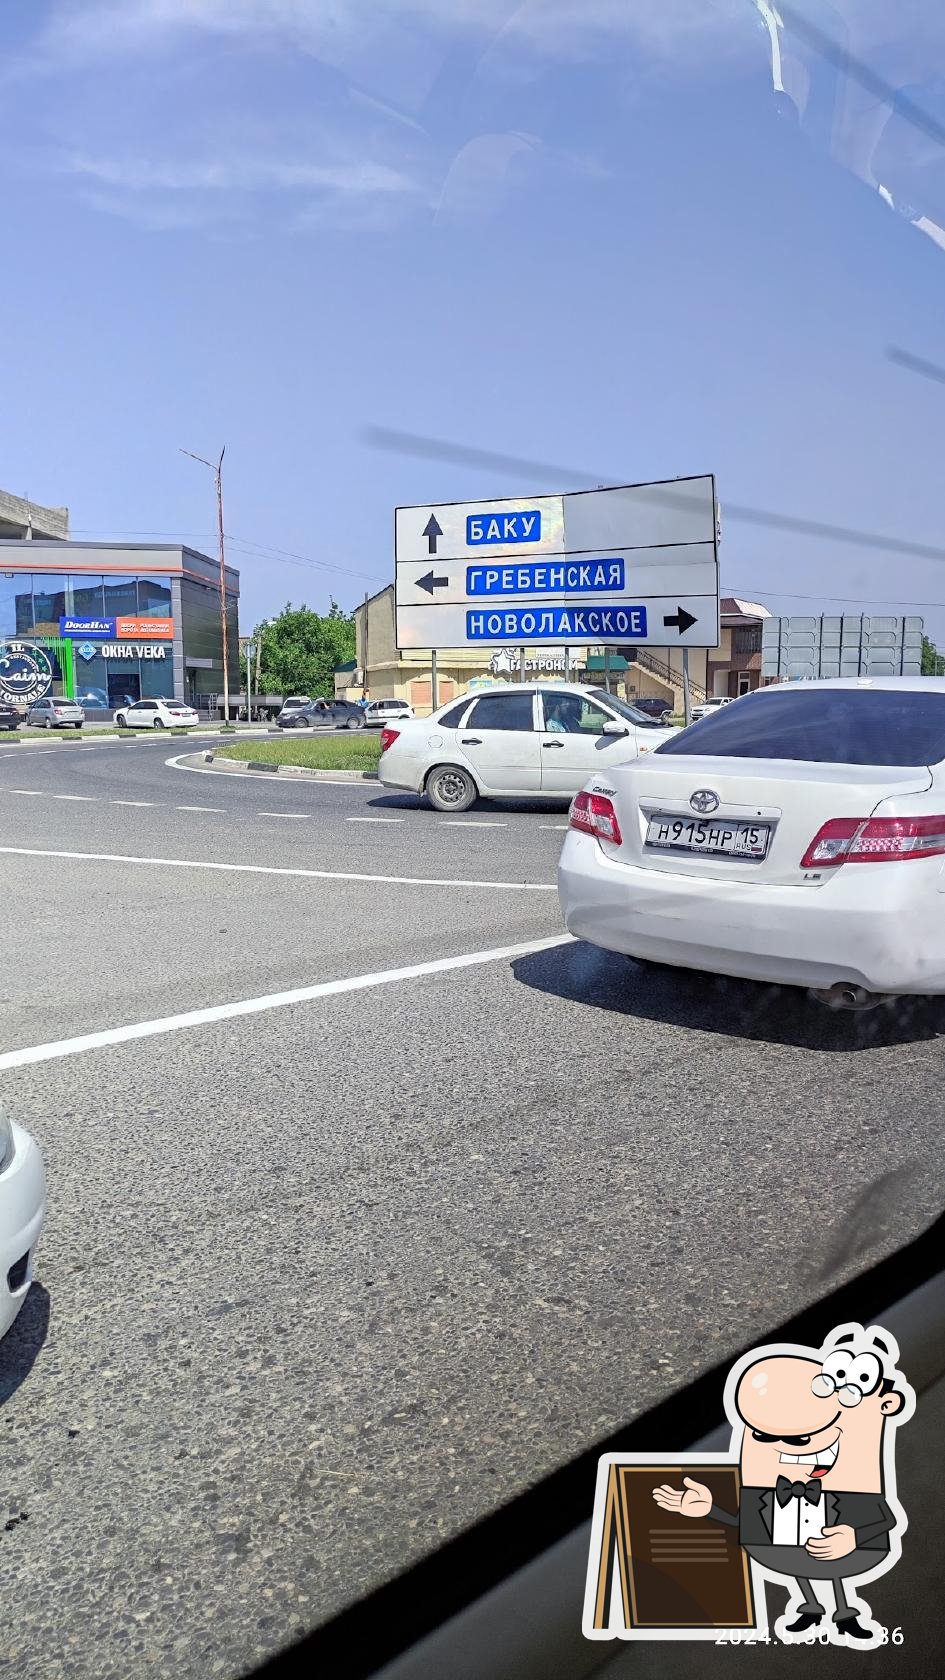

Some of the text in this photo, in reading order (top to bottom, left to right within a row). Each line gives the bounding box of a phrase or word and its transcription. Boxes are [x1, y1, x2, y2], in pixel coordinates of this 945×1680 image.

[470, 516, 537, 541] БАКУ
[469, 564, 622, 590] ГРЕБЕНСКАЯ
[470, 610, 642, 635] НОВОЛАКСКОЕ
[101, 645, 133, 658] ОКНА
[740, 827, 760, 844] 15
